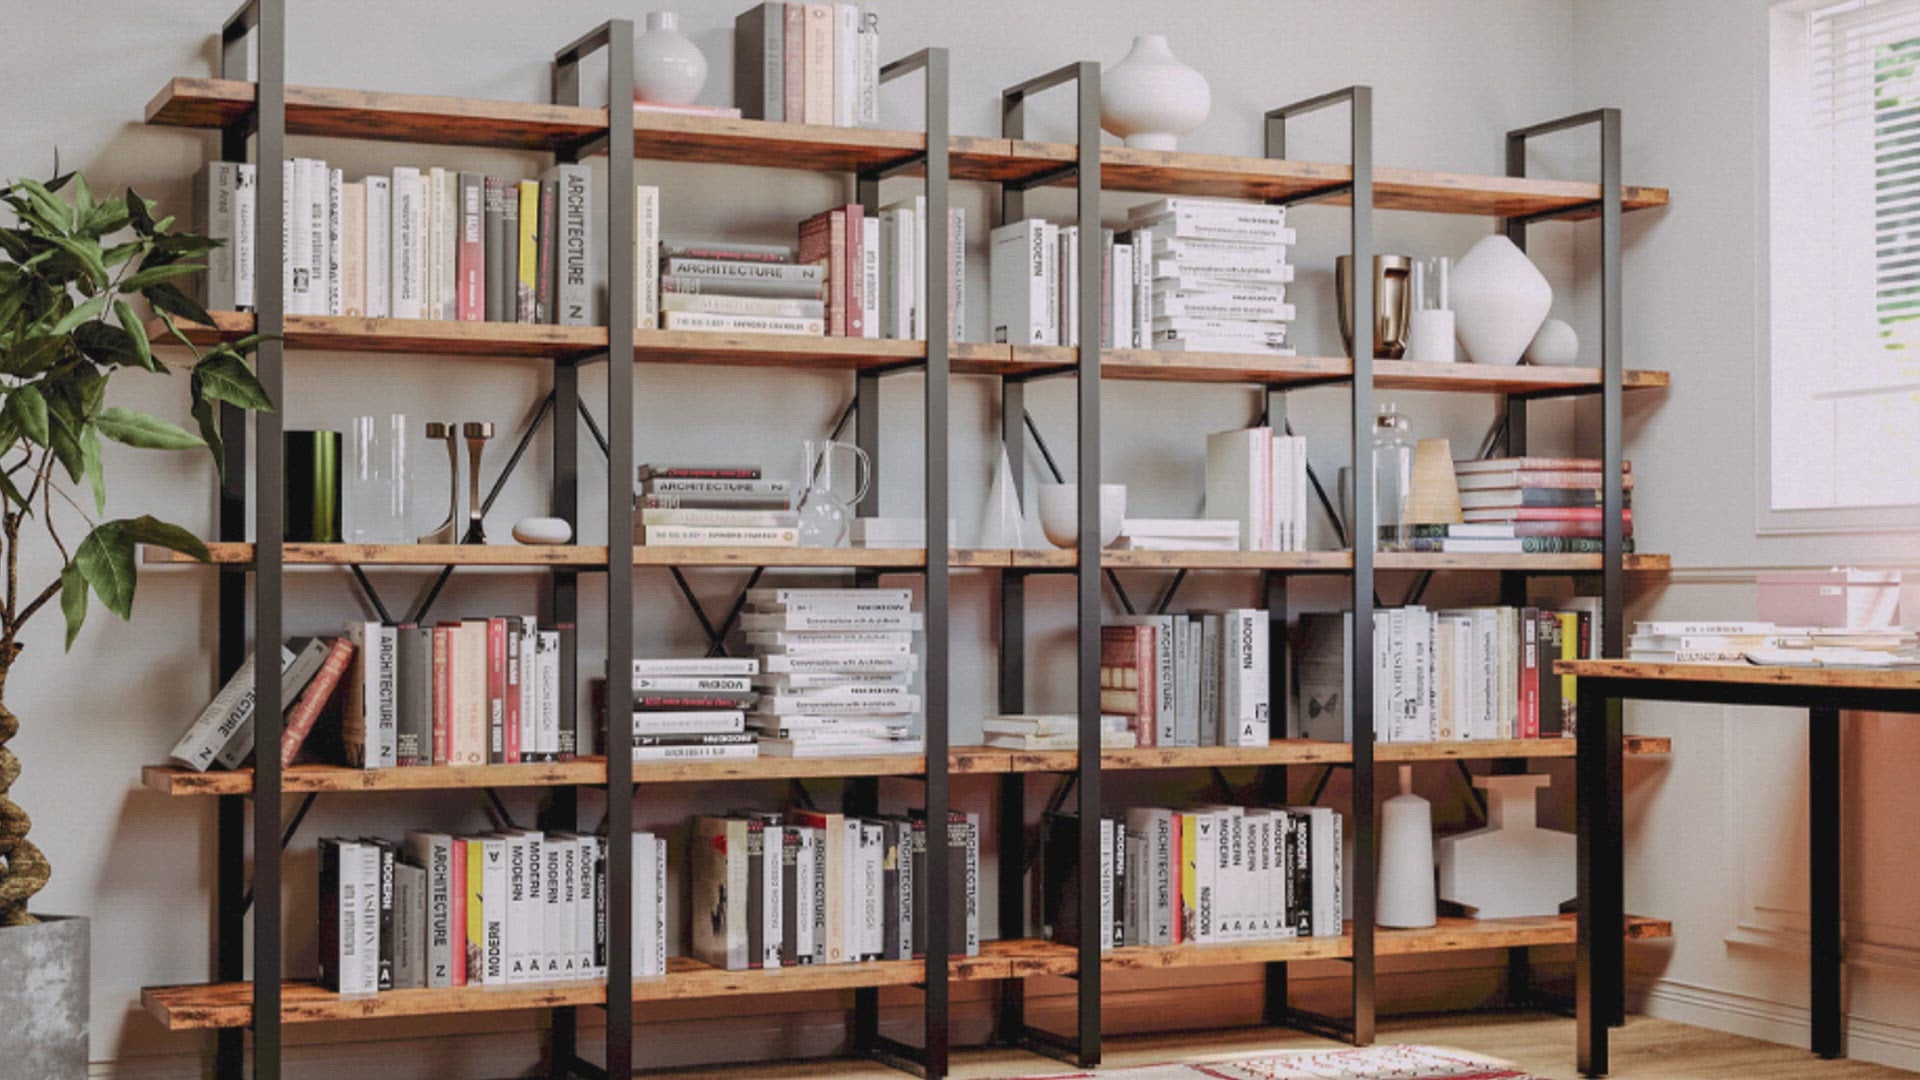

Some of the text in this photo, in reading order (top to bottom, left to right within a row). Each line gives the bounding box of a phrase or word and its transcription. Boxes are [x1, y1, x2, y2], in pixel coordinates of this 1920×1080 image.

[567, 173, 584, 285] ARCHITECTURE
[1033, 227, 1044, 278] MODERN
[676, 262, 783, 279] ARCHITECTURE
[659, 482, 754, 492] ARCHITECTURE
[1162, 623, 1173, 713] ARCHITECTURE
[1243, 617, 1253, 669] MODERN
[380, 635, 393, 729] ARCHITECTURE
[1116, 824, 1125, 877] MODERN
[1158, 818, 1169, 910] ARCHITECTURE
[1219, 818, 1229, 869] MODERN
[1232, 815, 1243, 867] MODERN
[1248, 823, 1258, 873] MODERN
[1261, 822, 1270, 871] MODERN
[1274, 818, 1283, 869] MODERN
[1297, 822, 1308, 870] MODERN
[383, 852, 393, 909] MODERN
[433, 845, 448, 947] ARCHITECTURE
[512, 845, 524, 902] MODERN
[529, 841, 541, 899] MODERN
[548, 851, 559, 904] MODERN
[566, 849, 574, 903] MODERN
[581, 845, 592, 900] MODERN
[815, 837, 825, 929] ARCHITECTURE
[902, 830, 911, 923] ARCHITECTURE
[966, 822, 976, 918] ARCHITECTURE
[364, 883, 375, 946] FASHION
[1200, 886, 1211, 936] MODERN
[488, 921, 500, 977] MODERN
